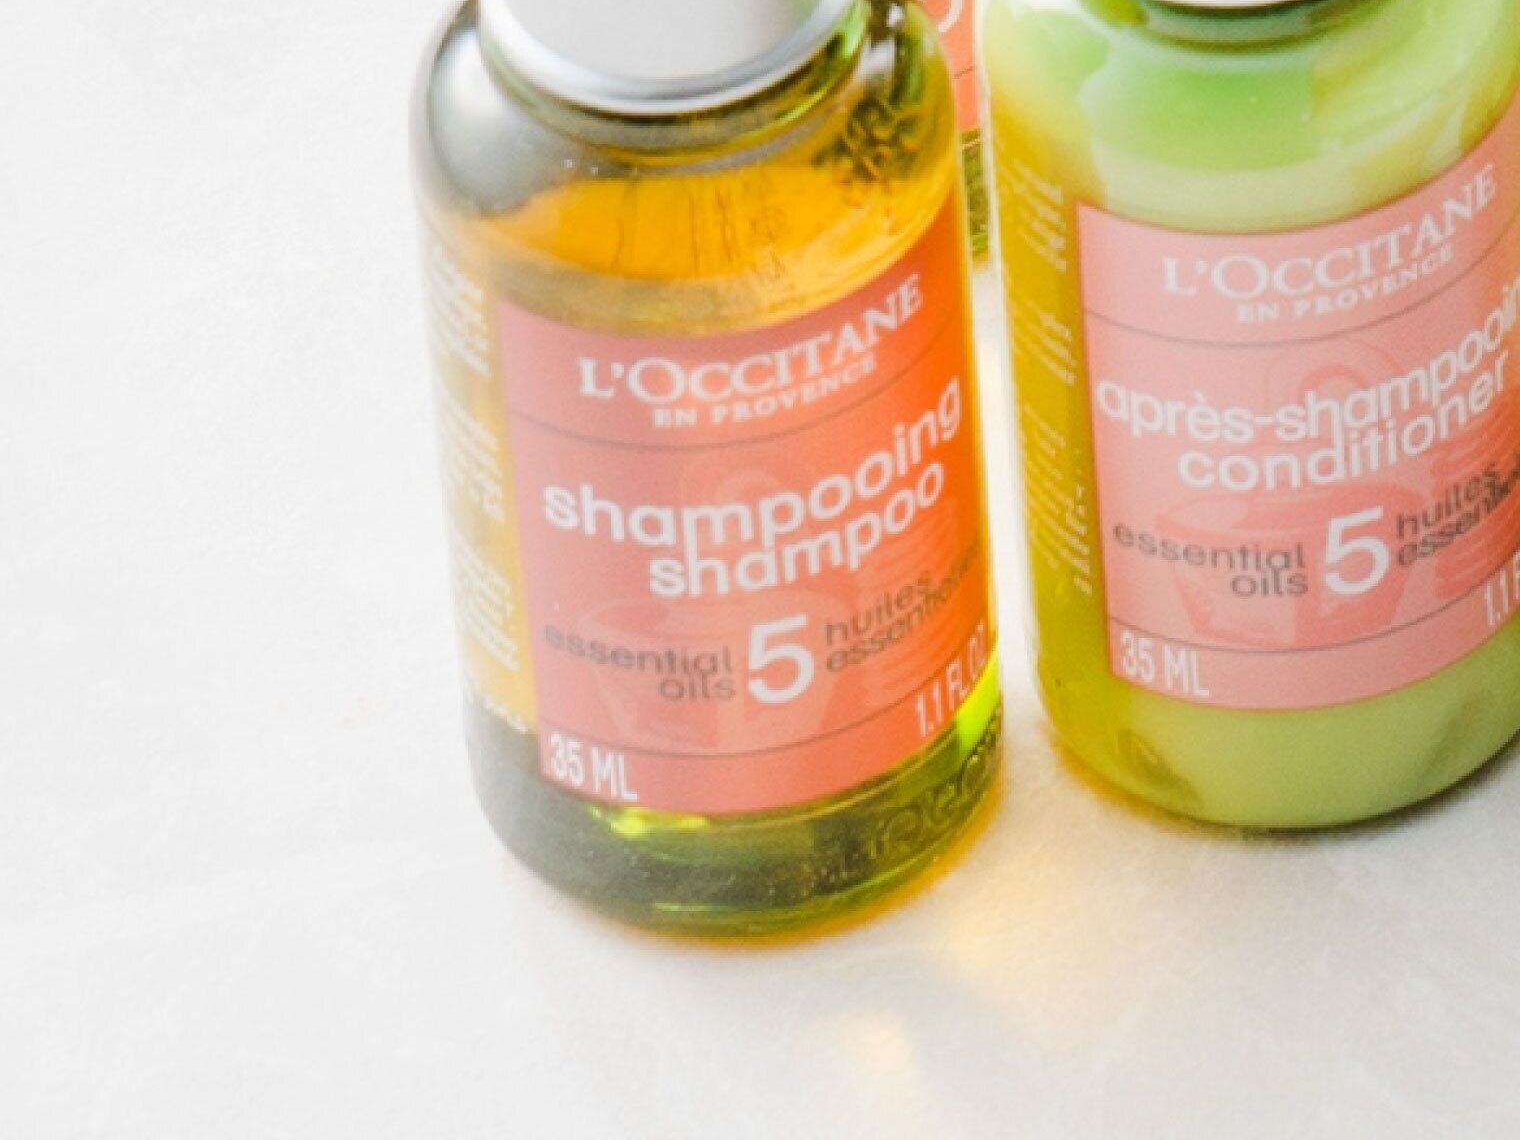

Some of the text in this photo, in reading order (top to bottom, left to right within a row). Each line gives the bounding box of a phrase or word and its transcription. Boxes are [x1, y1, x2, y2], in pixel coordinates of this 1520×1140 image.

[1162, 163, 1497, 298] L'OCCITANE
[1237, 246, 1455, 323] EN PROVENCE
[578, 273, 924, 405] L'OCCITANE
[653, 353, 876, 428] EN PROVENCE
[1178, 353, 1509, 492] conditioner
[543, 377, 961, 547] shampooing
[1396, 462, 1498, 540] huiles
[649, 462, 944, 597] shampoo
[1113, 522, 1308, 598] essential oils
[1325, 507, 1390, 595] 5
[826, 571, 931, 646] huiles
[543, 622, 736, 701] essential oils
[747, 614, 814, 704] 5
[1118, 629, 1211, 697] 35 ML
[915, 680, 942, 737] 1.1
[548, 732, 639, 802] 35 ML
